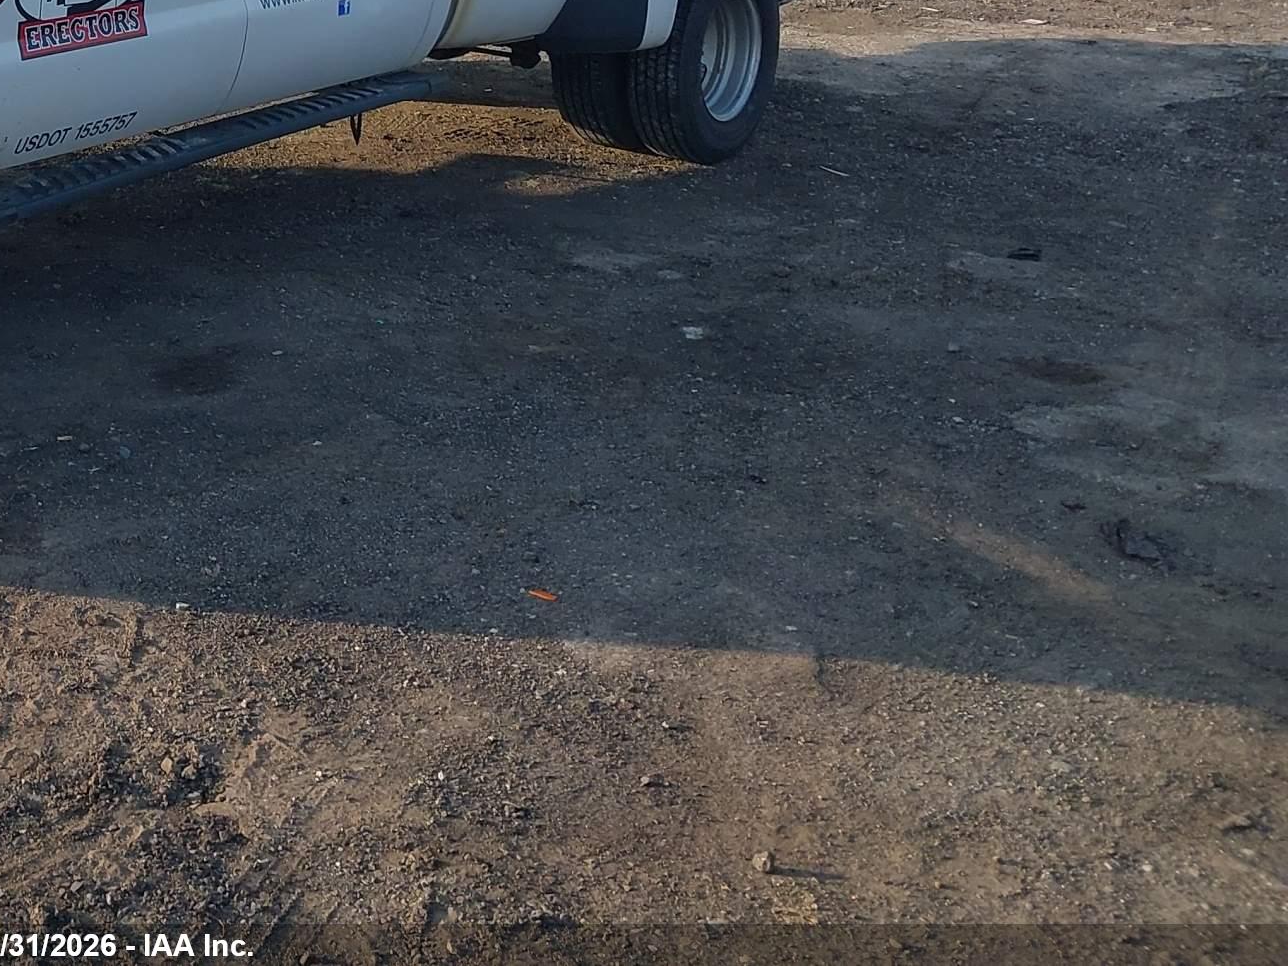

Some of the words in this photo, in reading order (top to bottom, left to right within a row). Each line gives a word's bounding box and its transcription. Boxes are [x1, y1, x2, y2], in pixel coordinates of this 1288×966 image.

[25, 5, 140, 52] ERECTORS
[14, 127, 72, 154] USDOT
[75, 111, 137, 140] 1555757
